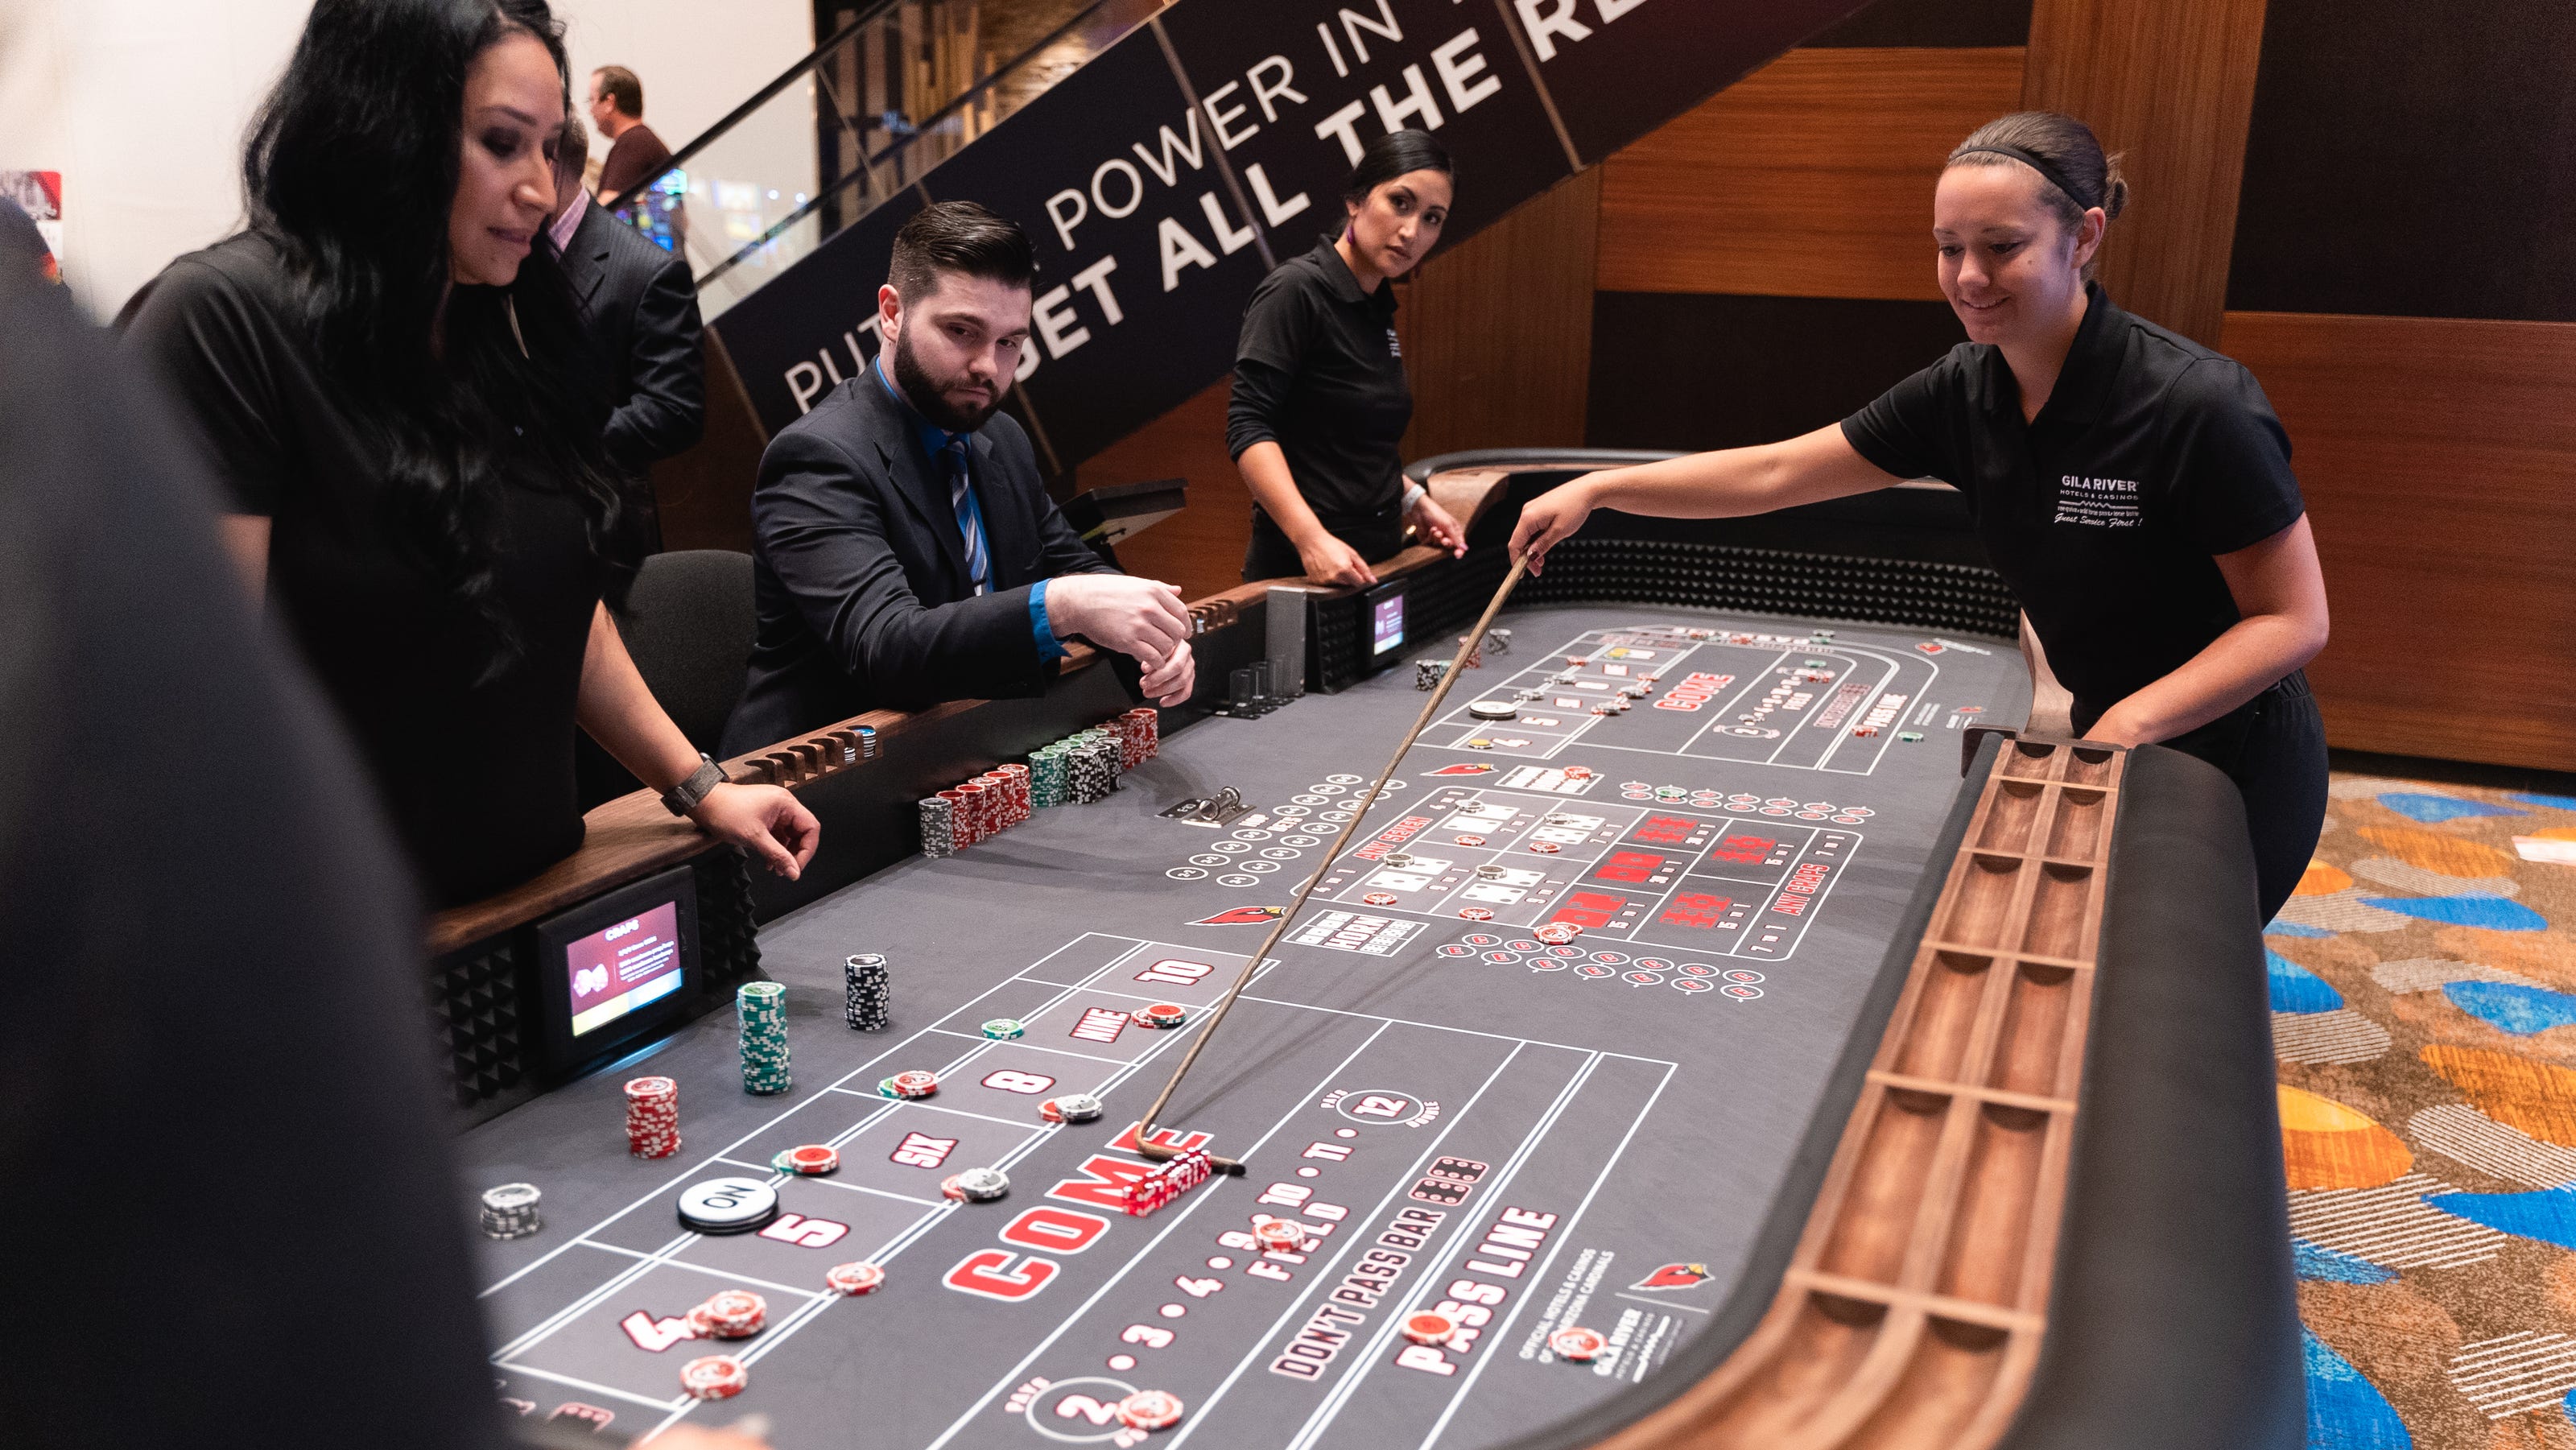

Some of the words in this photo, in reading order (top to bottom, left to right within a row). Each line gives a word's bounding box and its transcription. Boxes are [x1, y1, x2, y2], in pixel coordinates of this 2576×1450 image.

[1046, 55, 1308, 251] POWER
[1317, 0, 1403, 77] IN
[1158, 162, 1311, 292] ALL
[1314, 27, 1502, 169] THE
[2060, 490, 2089, 498] HOTELS
[2062, 475, 2091, 490] GILA
[2093, 478, 2136, 492] RIVER
[2054, 513, 2079, 523] Guest
[2079, 515, 2106, 526] Service
[2108, 518, 2133, 528] First
[1653, 671, 1736, 712] COME
[1352, 840, 1397, 861] ANY
[1378, 816, 1433, 842] SEVEN
[1764, 857, 1785, 866] 15
[1771, 892, 1811, 916] ANY
[1793, 863, 1830, 894] CRAPS
[605, 919, 639, 941] CRAPS
[1322, 915, 1392, 950] HORN
[1607, 919, 1630, 930] 15
[1716, 920, 1740, 930] 15
[1749, 945, 1774, 953] 7
[1133, 959, 1215, 986] 10
[1731, 987, 1754, 997] E
[1069, 1007, 1132, 1043] NINE
[980, 1069, 1056, 1094] 8
[1319, 1089, 1349, 1109] PAYS
[1351, 1095, 1409, 1118] 12
[890, 1131, 960, 1170] SIX
[702, 1184, 757, 1208] ON
[942, 1121, 1215, 1302] COME
[758, 1213, 850, 1248] 5
[1464, 1206, 1559, 1279] LINE
[1055, 1394, 1118, 1425] 2
[1122, 1323, 1176, 1349] 3
[1174, 1275, 1224, 1298] 4
[1216, 1230, 1257, 1251] 9
[1256, 1182, 1314, 1208] 10
[1302, 1141, 1356, 1162] 11
[1269, 1303, 1366, 1382] DON'T
[1328, 1248, 1412, 1309] PASS
[1377, 1206, 1447, 1251] BAR
[1558, 1294, 1590, 1330] ARIZONA
[1579, 1250, 1615, 1294] CARDINALS
[1519, 1320, 1554, 1359] OFFICIAL
[1542, 1287, 1573, 1320] HOTELS
[1567, 1248, 1596, 1282] CASINOS
[619, 1310, 695, 1353] 4
[1608, 1307, 1642, 1346] RIVER
[1005, 1376, 1051, 1412] PAYS
